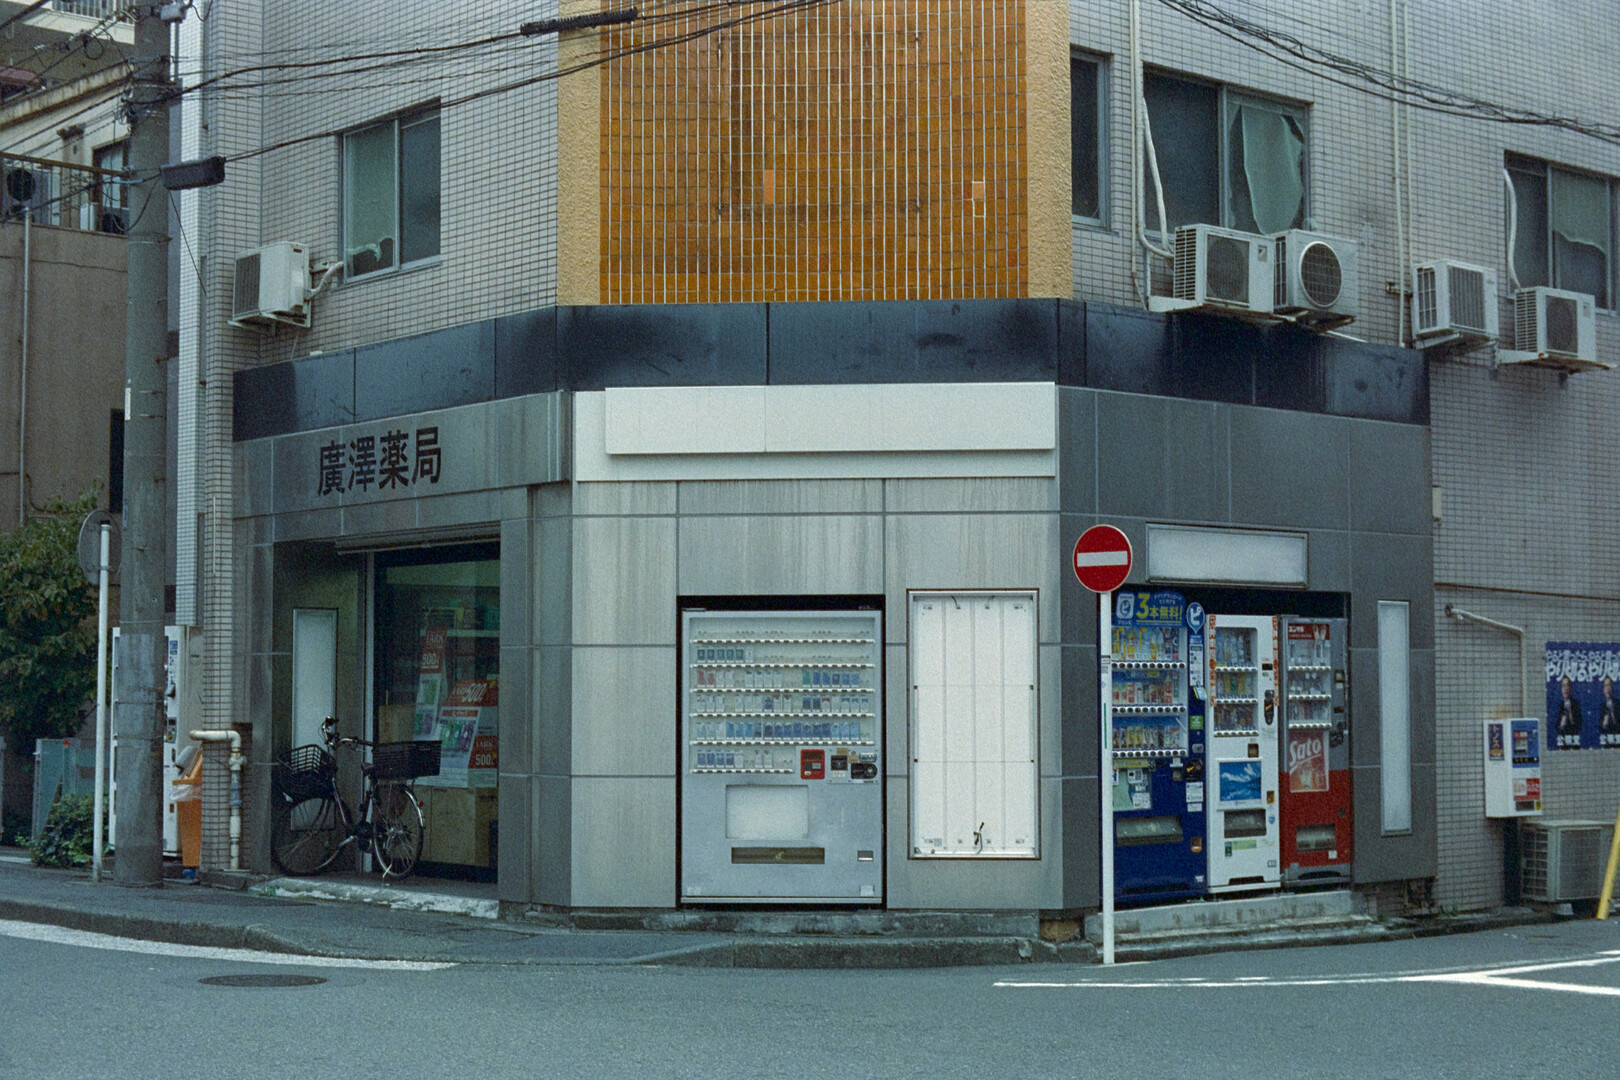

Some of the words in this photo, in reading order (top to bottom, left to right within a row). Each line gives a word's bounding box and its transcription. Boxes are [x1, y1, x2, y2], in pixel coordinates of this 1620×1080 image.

[318, 426, 442, 497] 廣澤薬局
[1289, 738, 1322, 767] Sato
